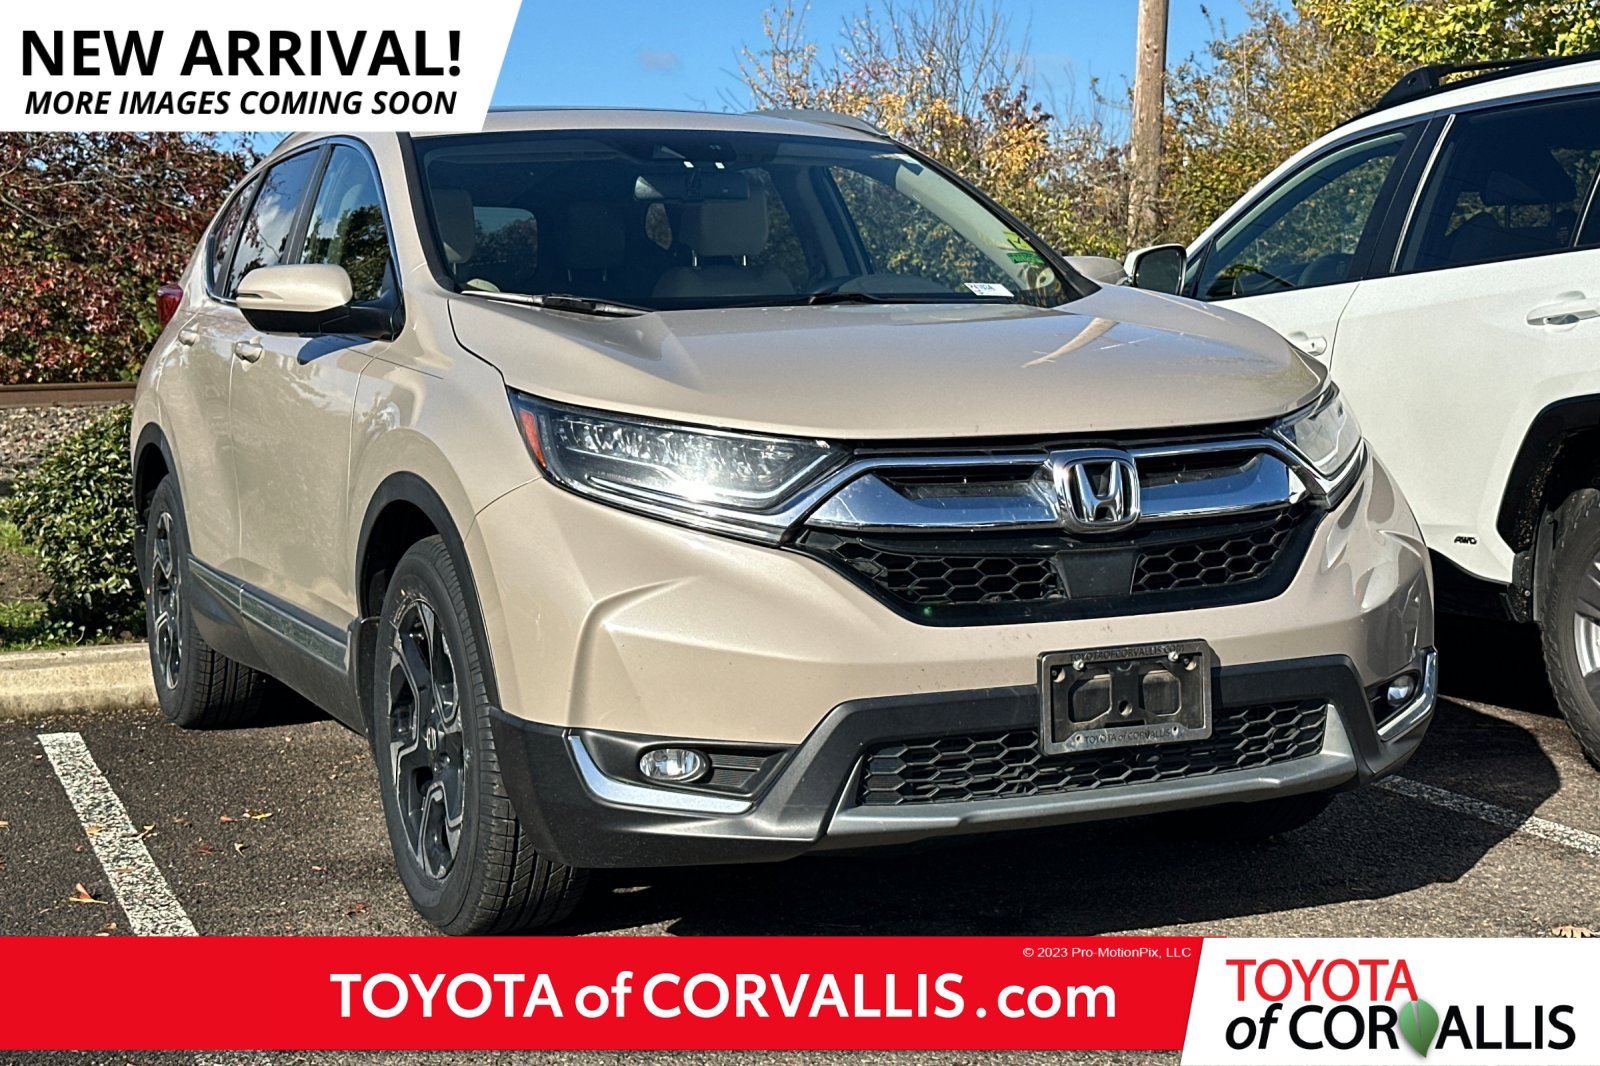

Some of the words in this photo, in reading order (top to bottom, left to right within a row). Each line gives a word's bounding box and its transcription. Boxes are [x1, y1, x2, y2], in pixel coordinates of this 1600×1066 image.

[1453, 535, 1478, 545] AWD
[1084, 733, 1117, 744] TOYOTA
[1127, 727, 1171, 741] CORVALLIS
